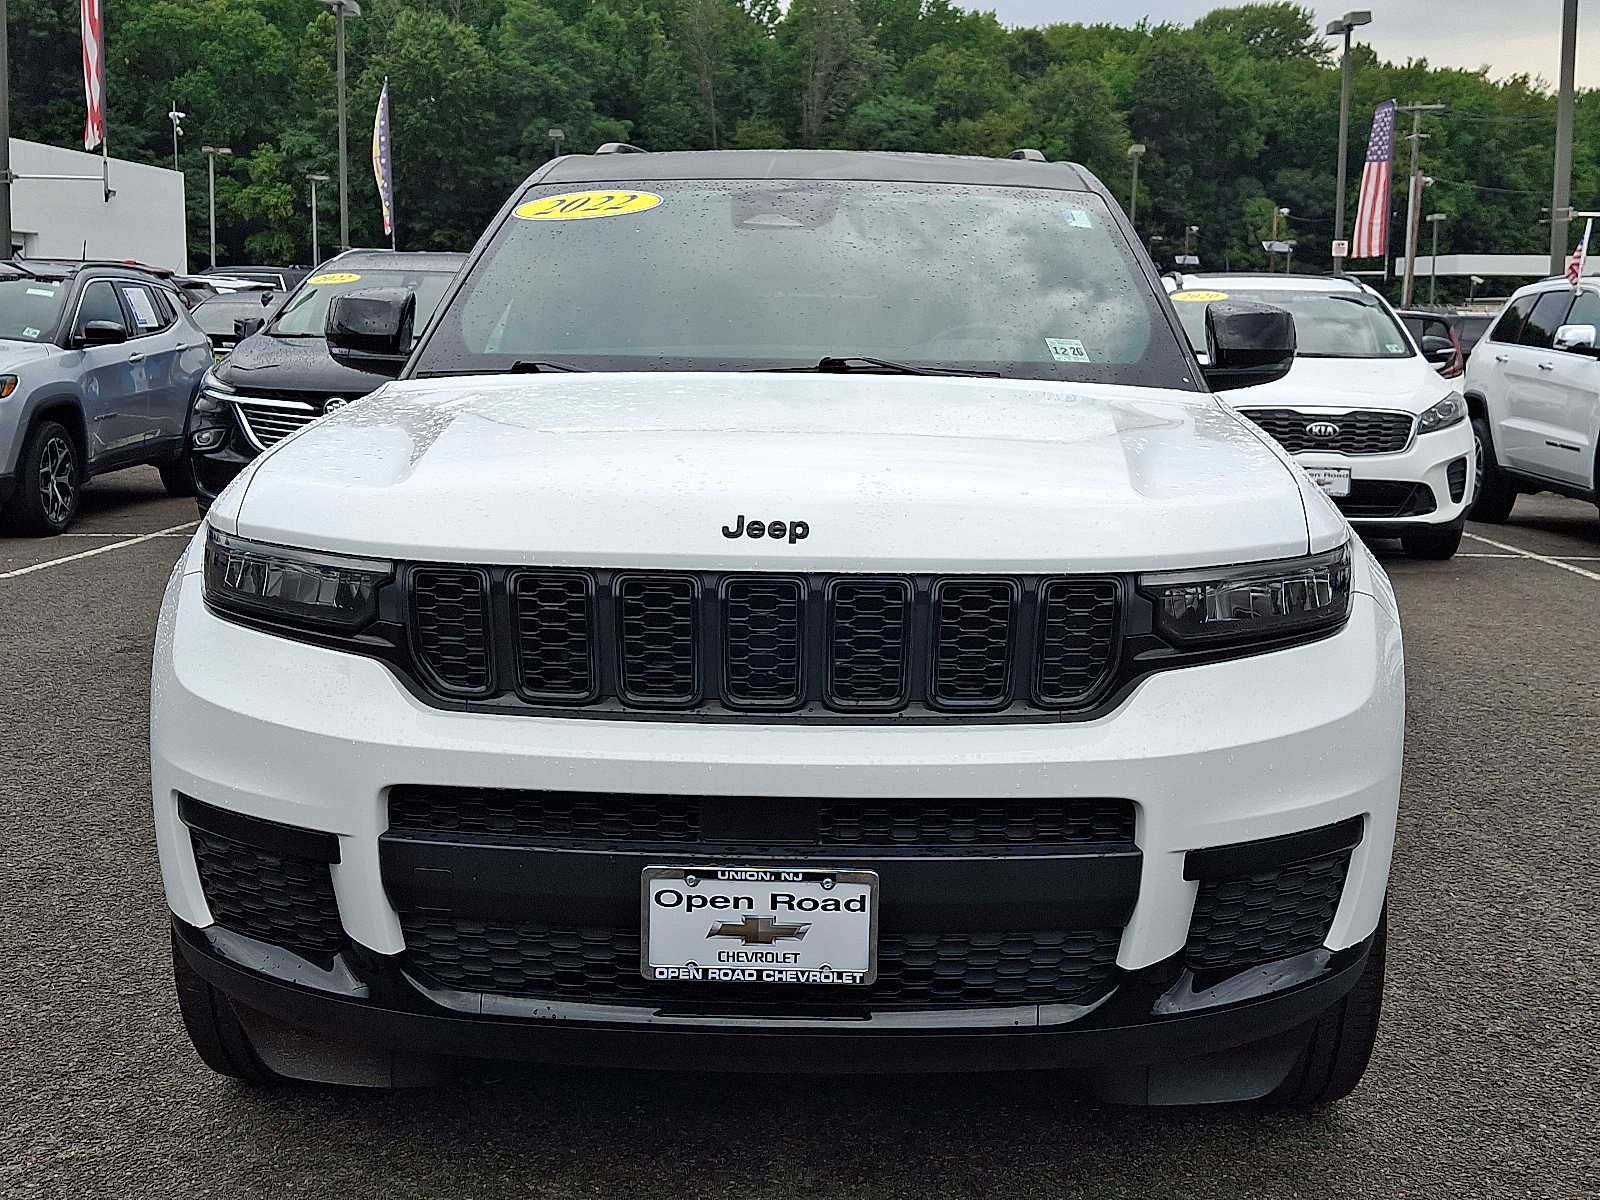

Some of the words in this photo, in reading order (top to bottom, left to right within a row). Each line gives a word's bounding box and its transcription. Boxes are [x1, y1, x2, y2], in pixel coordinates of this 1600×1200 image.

[533, 194, 638, 216] 2022
[1311, 424, 1334, 436] KIA
[722, 515, 810, 544] Jeep
[717, 871, 775, 881] UNION,
[781, 871, 803, 881] NJ
[654, 889, 754, 912] Open
[770, 893, 866, 913] Road
[717, 951, 801, 964] CHEVROLET
[655, 967, 703, 980] OPEN
[707, 968, 757, 981] ROAD
[762, 969, 863, 984] CHEVROLET
